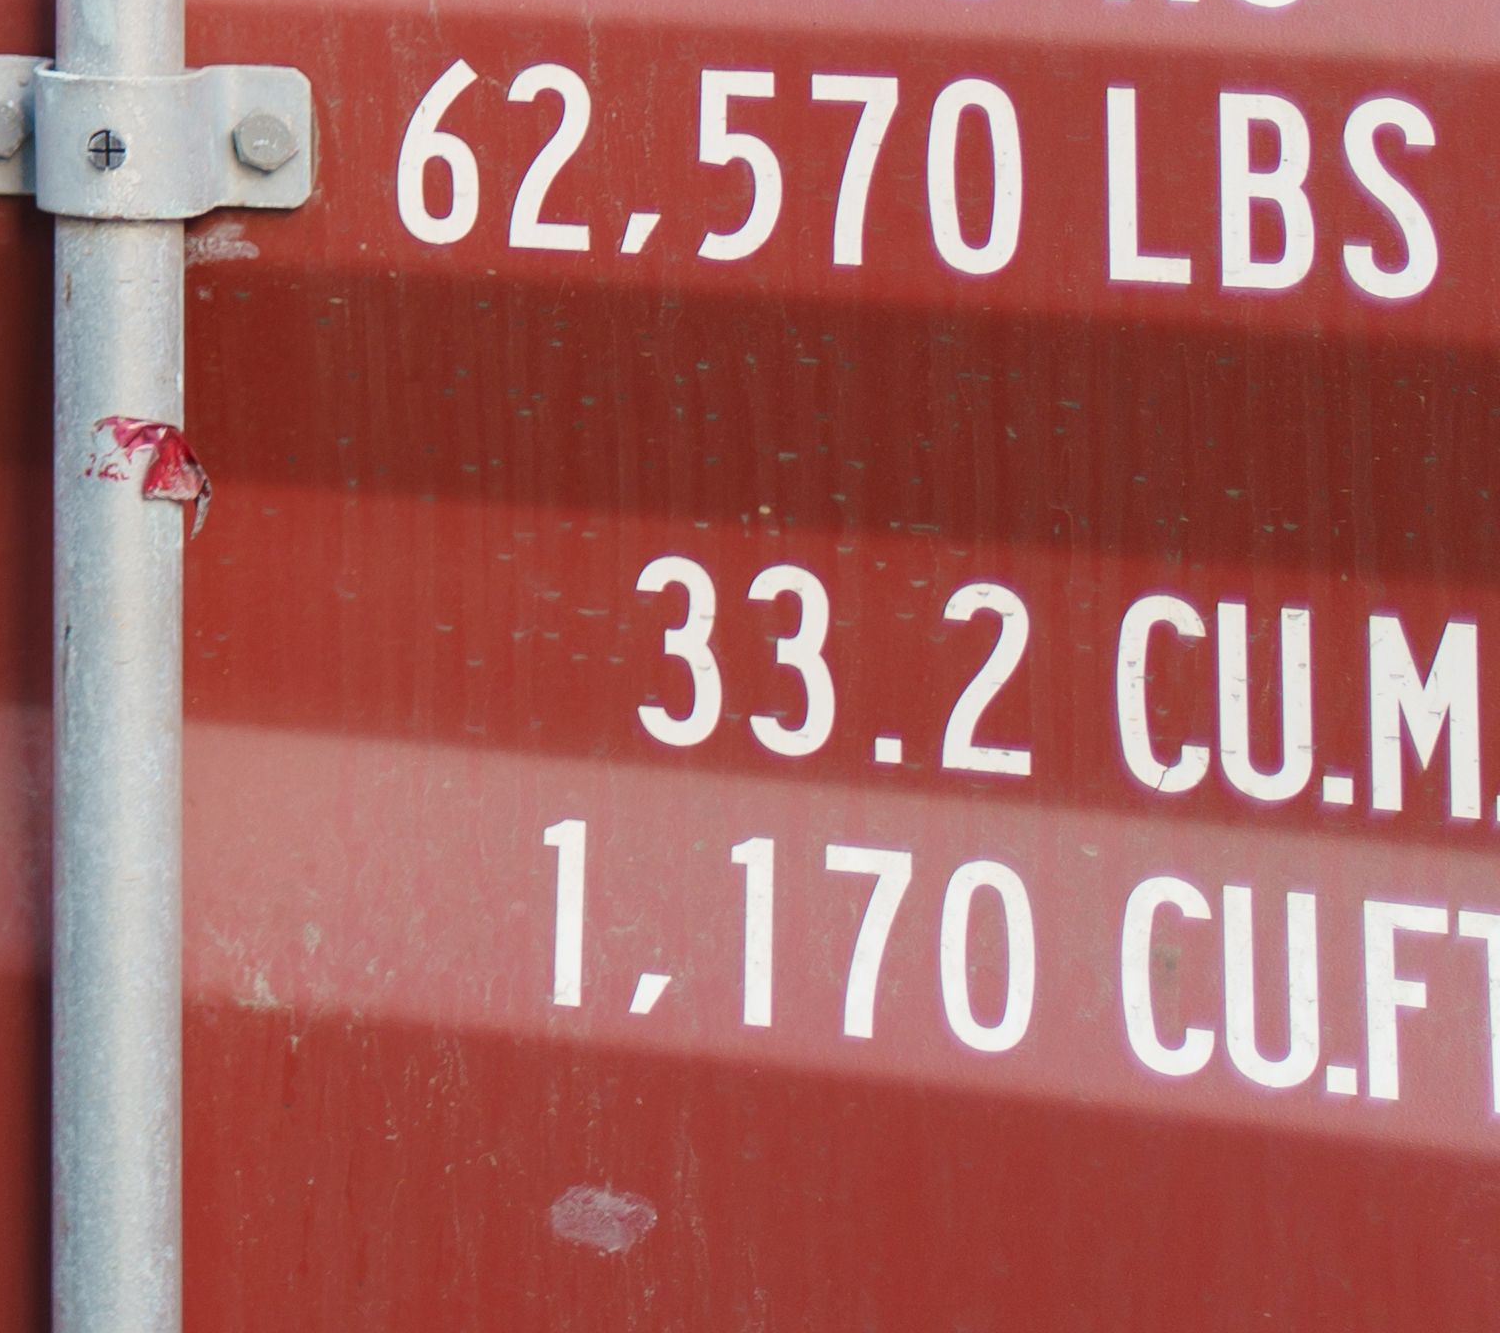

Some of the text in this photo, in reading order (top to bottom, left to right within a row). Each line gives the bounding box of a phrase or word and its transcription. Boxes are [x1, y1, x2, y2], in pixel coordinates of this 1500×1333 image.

[395, 58, 1439, 300] 62,570 LBS
[635, 555, 1500, 823] 33.2 CU.M
[542, 817, 1037, 1054] 1,170
